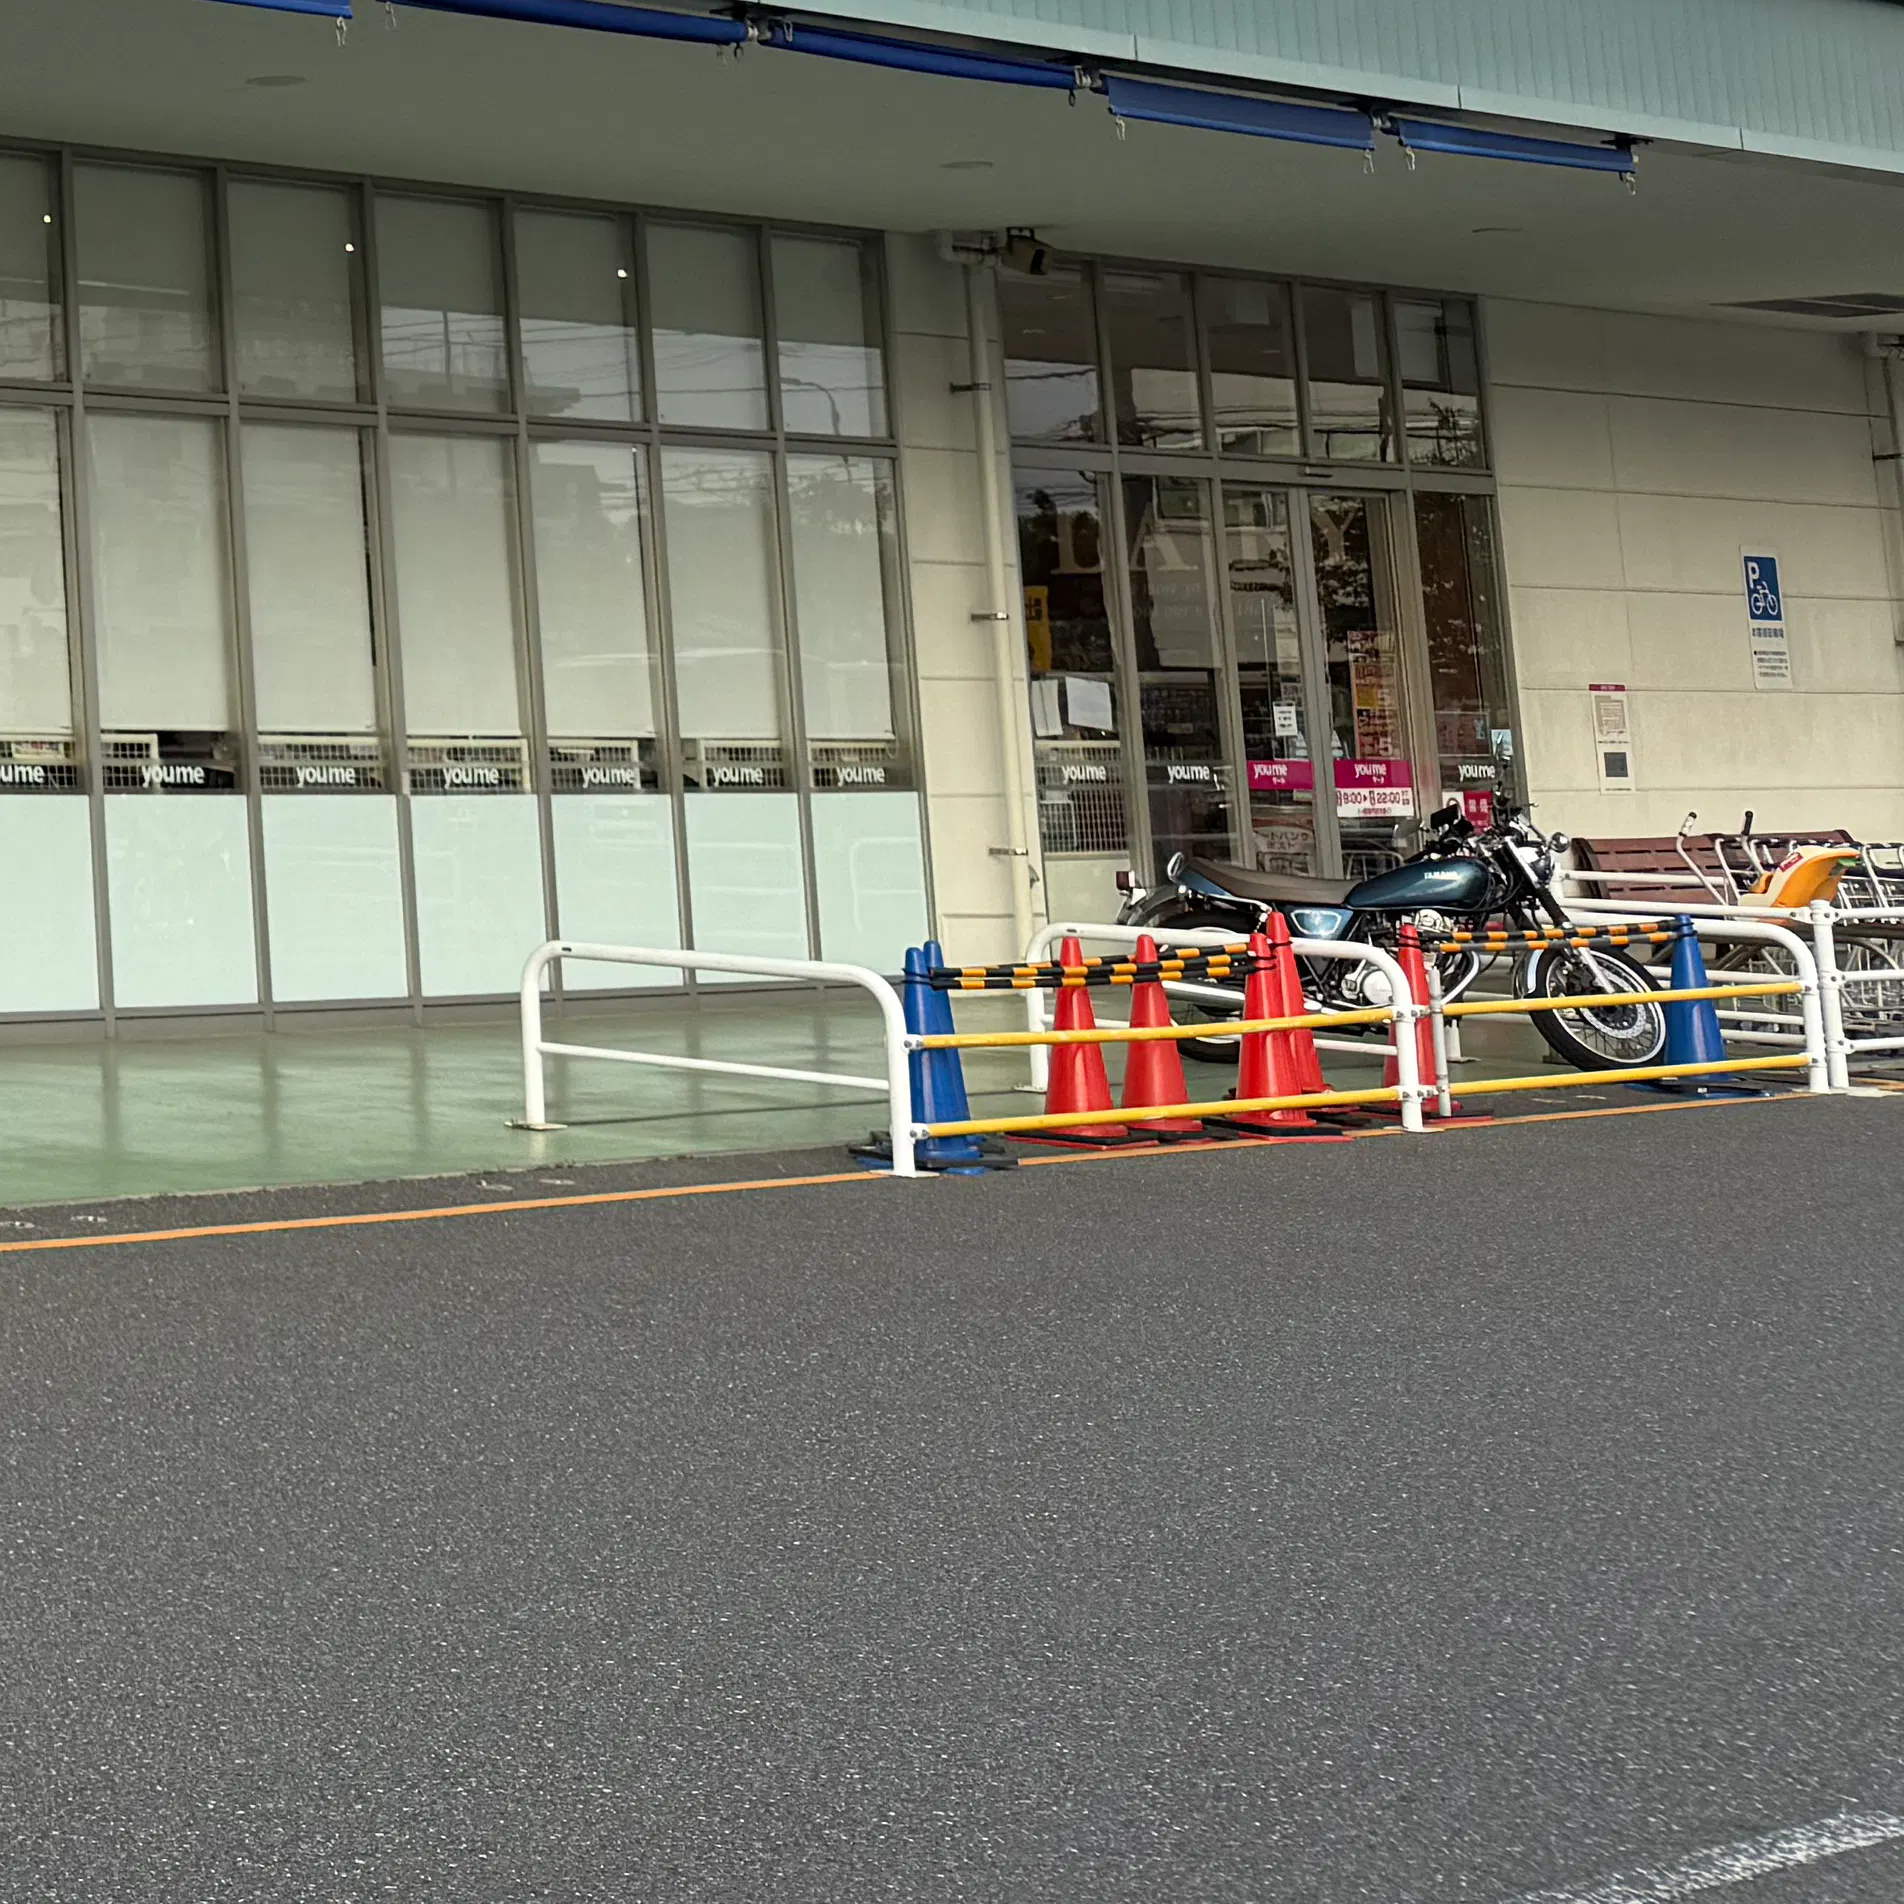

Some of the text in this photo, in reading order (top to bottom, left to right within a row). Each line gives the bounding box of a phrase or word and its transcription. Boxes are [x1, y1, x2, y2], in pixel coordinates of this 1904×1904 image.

[1747, 561, 1760, 589] P
[141, 765, 205, 788] youme
[296, 765, 356, 788] youme
[442, 766, 499, 789] youme
[581, 766, 635, 788] youme
[712, 766, 763, 787] youme
[836, 766, 885, 787] youme
[1061, 764, 1107, 785] youme
[1167, 764, 1210, 784] youme
[1253, 764, 1288, 779] youme
[1354, 763, 1387, 779] youme
[1458, 764, 1496, 782] youme
